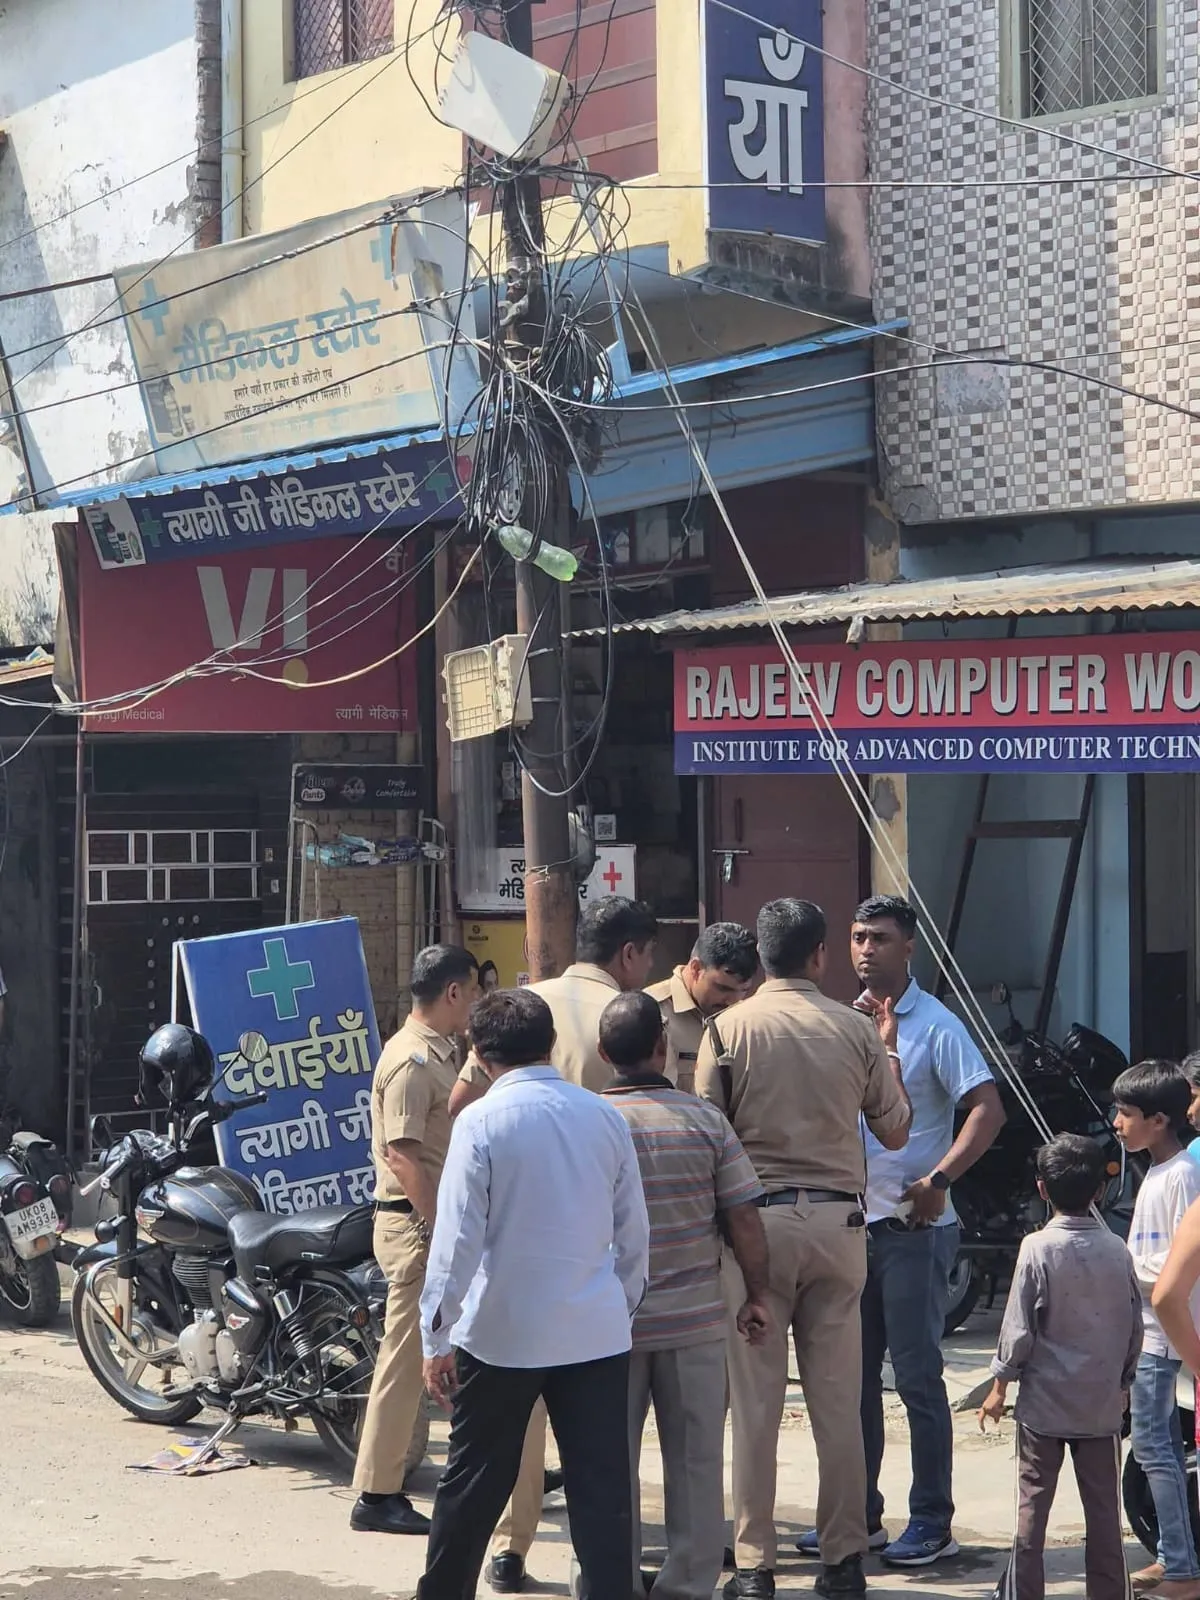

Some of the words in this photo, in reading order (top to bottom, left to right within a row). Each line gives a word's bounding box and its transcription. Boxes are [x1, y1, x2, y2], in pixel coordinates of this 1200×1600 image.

[724, 28, 808, 195] याँ
[306, 287, 380, 358] स्टोर
[233, 384, 248, 400] हमारे
[163, 490, 231, 545] त्यागी
[227, 488, 268, 534] जी
[264, 476, 361, 529] मैडिकल
[359, 462, 422, 515] स्टोर
[122, 708, 165, 720] Medical
[335, 704, 363, 720] त्यागी
[686, 661, 842, 720] RAJEEV
[856, 654, 1108, 716] COMPUTER
[692, 739, 801, 763] INSTITUTE
[806, 739, 851, 761] FOR
[854, 737, 974, 761] ADVANCED
[979, 737, 1112, 760] COMPUTER
[218, 1008, 372, 1094] दवाईयाँ
[236, 1100, 331, 1163] त्यागी
[334, 1089, 373, 1141] जी
[19, 1202, 47, 1221] UK08
